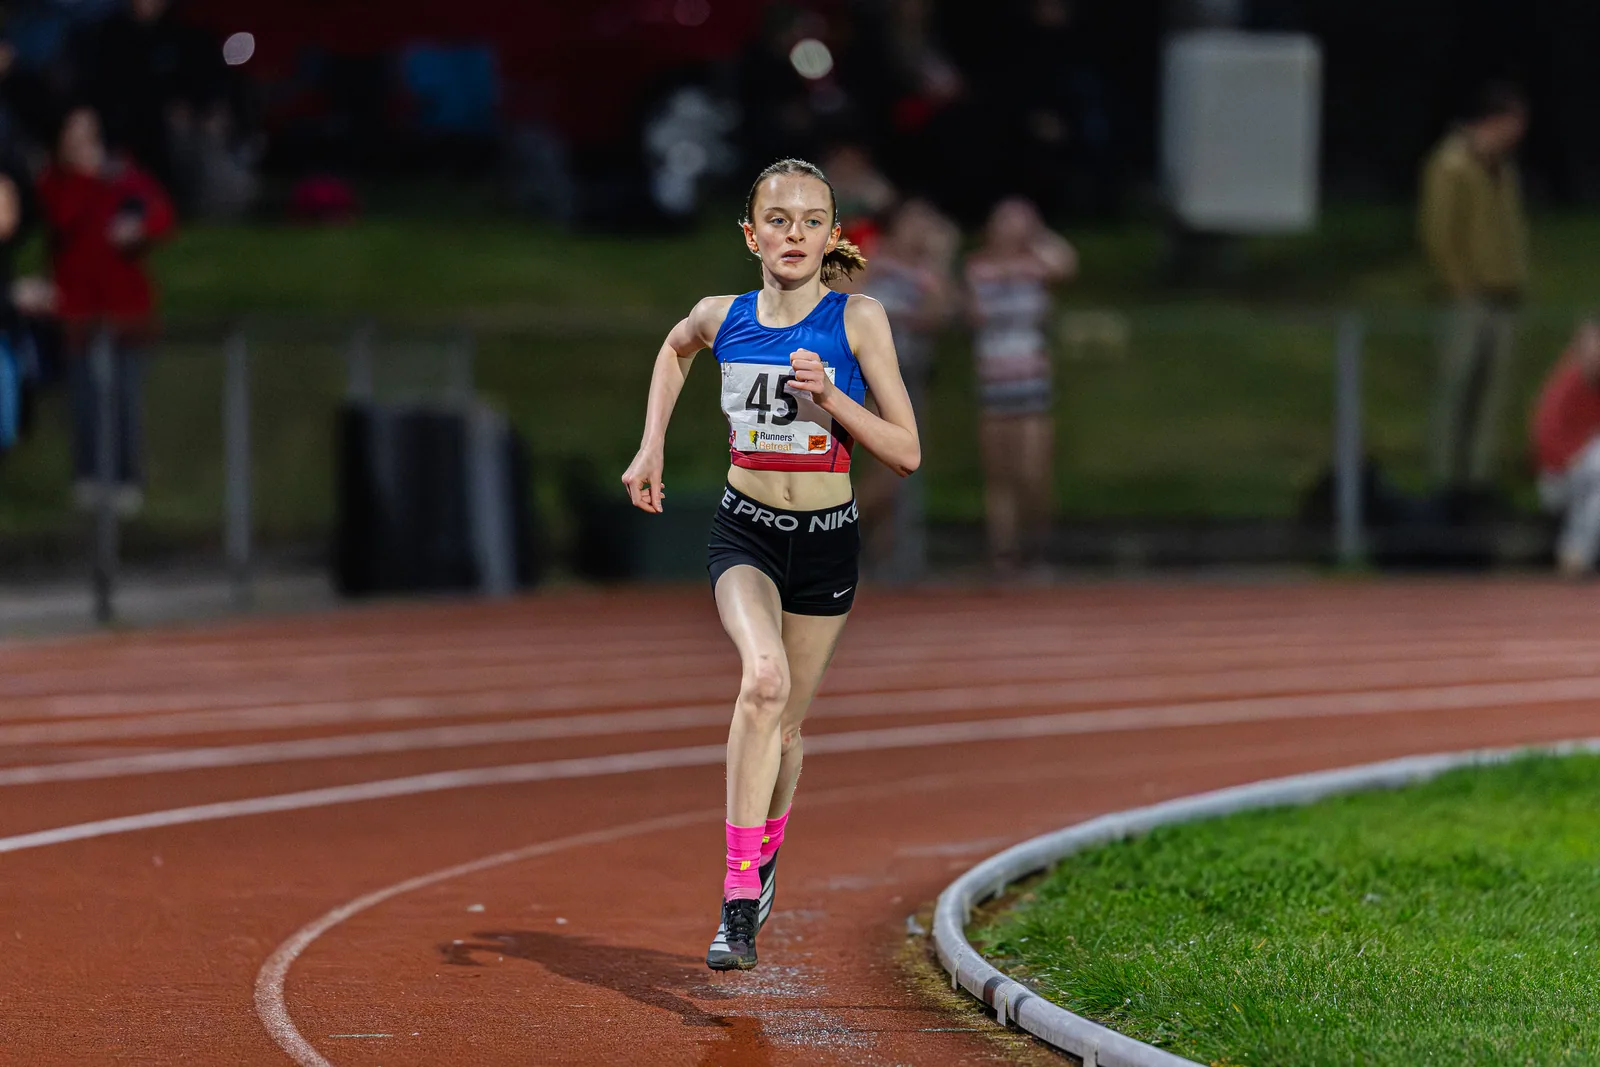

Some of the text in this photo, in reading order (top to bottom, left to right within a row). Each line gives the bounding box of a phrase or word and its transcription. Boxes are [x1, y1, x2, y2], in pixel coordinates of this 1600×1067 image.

[745, 373, 798, 426] 45
[759, 431, 795, 442] Runners'
[759, 441, 793, 451] Retreat
[733, 499, 799, 531] PRO
[808, 498, 859, 533] NIKE
